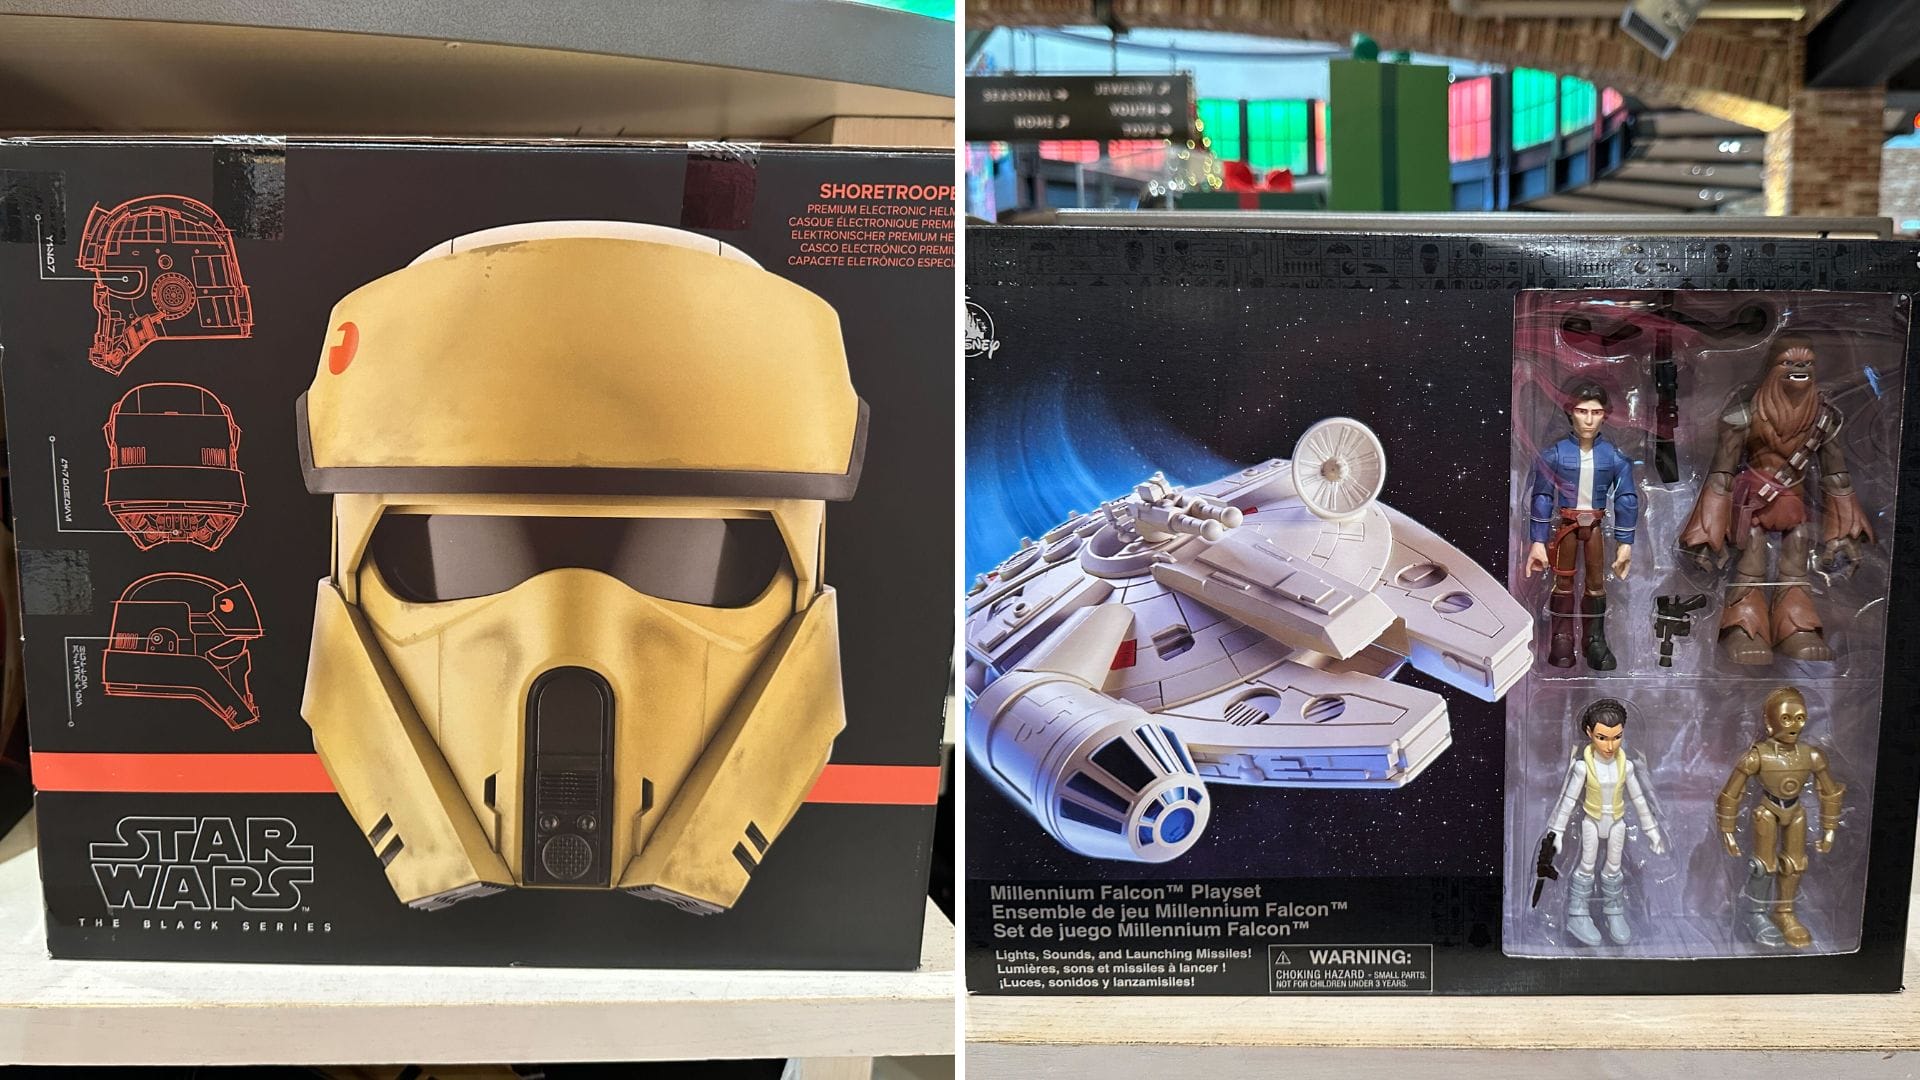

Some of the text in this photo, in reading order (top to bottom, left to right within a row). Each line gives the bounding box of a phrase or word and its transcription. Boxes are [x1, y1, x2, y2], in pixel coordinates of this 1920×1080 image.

[982, 88, 1051, 102] SEASONAL
[1109, 103, 1155, 116] YOUTH
[1014, 115, 1053, 128] HOME
[807, 204, 857, 215] PREMIUM
[859, 205, 926, 216] ELECTRONIC
[788, 216, 955, 229] CASQUE ÉLECTRONIQUE PREMI
[791, 230, 885, 241] ELEKTRONISCHER
[888, 231, 937, 242] PREMIUM
[800, 243, 838, 253] CASCO
[841, 242, 916, 255] ELECTRÓNICO
[788, 254, 955, 268] CAPACETE ELETRÔNICO ESPECI
[89, 816, 314, 862] STAR
[91, 864, 314, 911] WARS
[990, 885, 1094, 900] Millennium
[1191, 884, 1262, 902] Playset
[992, 904, 1087, 919] Ensemble
[1091, 904, 1115, 919] de
[1120, 904, 1149, 922] jeu
[1155, 903, 1259, 918] Millennium
[78, 917, 332, 932] THE BLACK SERIES
[993, 923, 1025, 938] Set
[1030, 923, 1053, 938] de
[1058, 923, 1112, 941] juego
[1118, 922, 1221, 937] Millennium
[995, 948, 1252, 962] Lights, Sounds, and Launching Missiles!
[1309, 949, 1412, 964] WARNING:
[997, 963, 1060, 975] Lumières,
[1063, 964, 1094, 973] sons
[1097, 963, 1110, 973] et
[1113, 962, 1165, 973] missiles
[1168, 962, 1176, 972] à
[1179, 962, 1218, 973] lancer
[1275, 969, 1321, 979] CHOKING
[1324, 969, 1365, 979] HAZARD
[1373, 971, 1399, 979] SMALL
[1401, 971, 1427, 979] PARTS.
[999, 976, 1195, 989] ¡Luces, sonidos y lanzamisiles!
[1276, 980, 1291, 988] NOT
[1293, 980, 1308, 988] FOR
